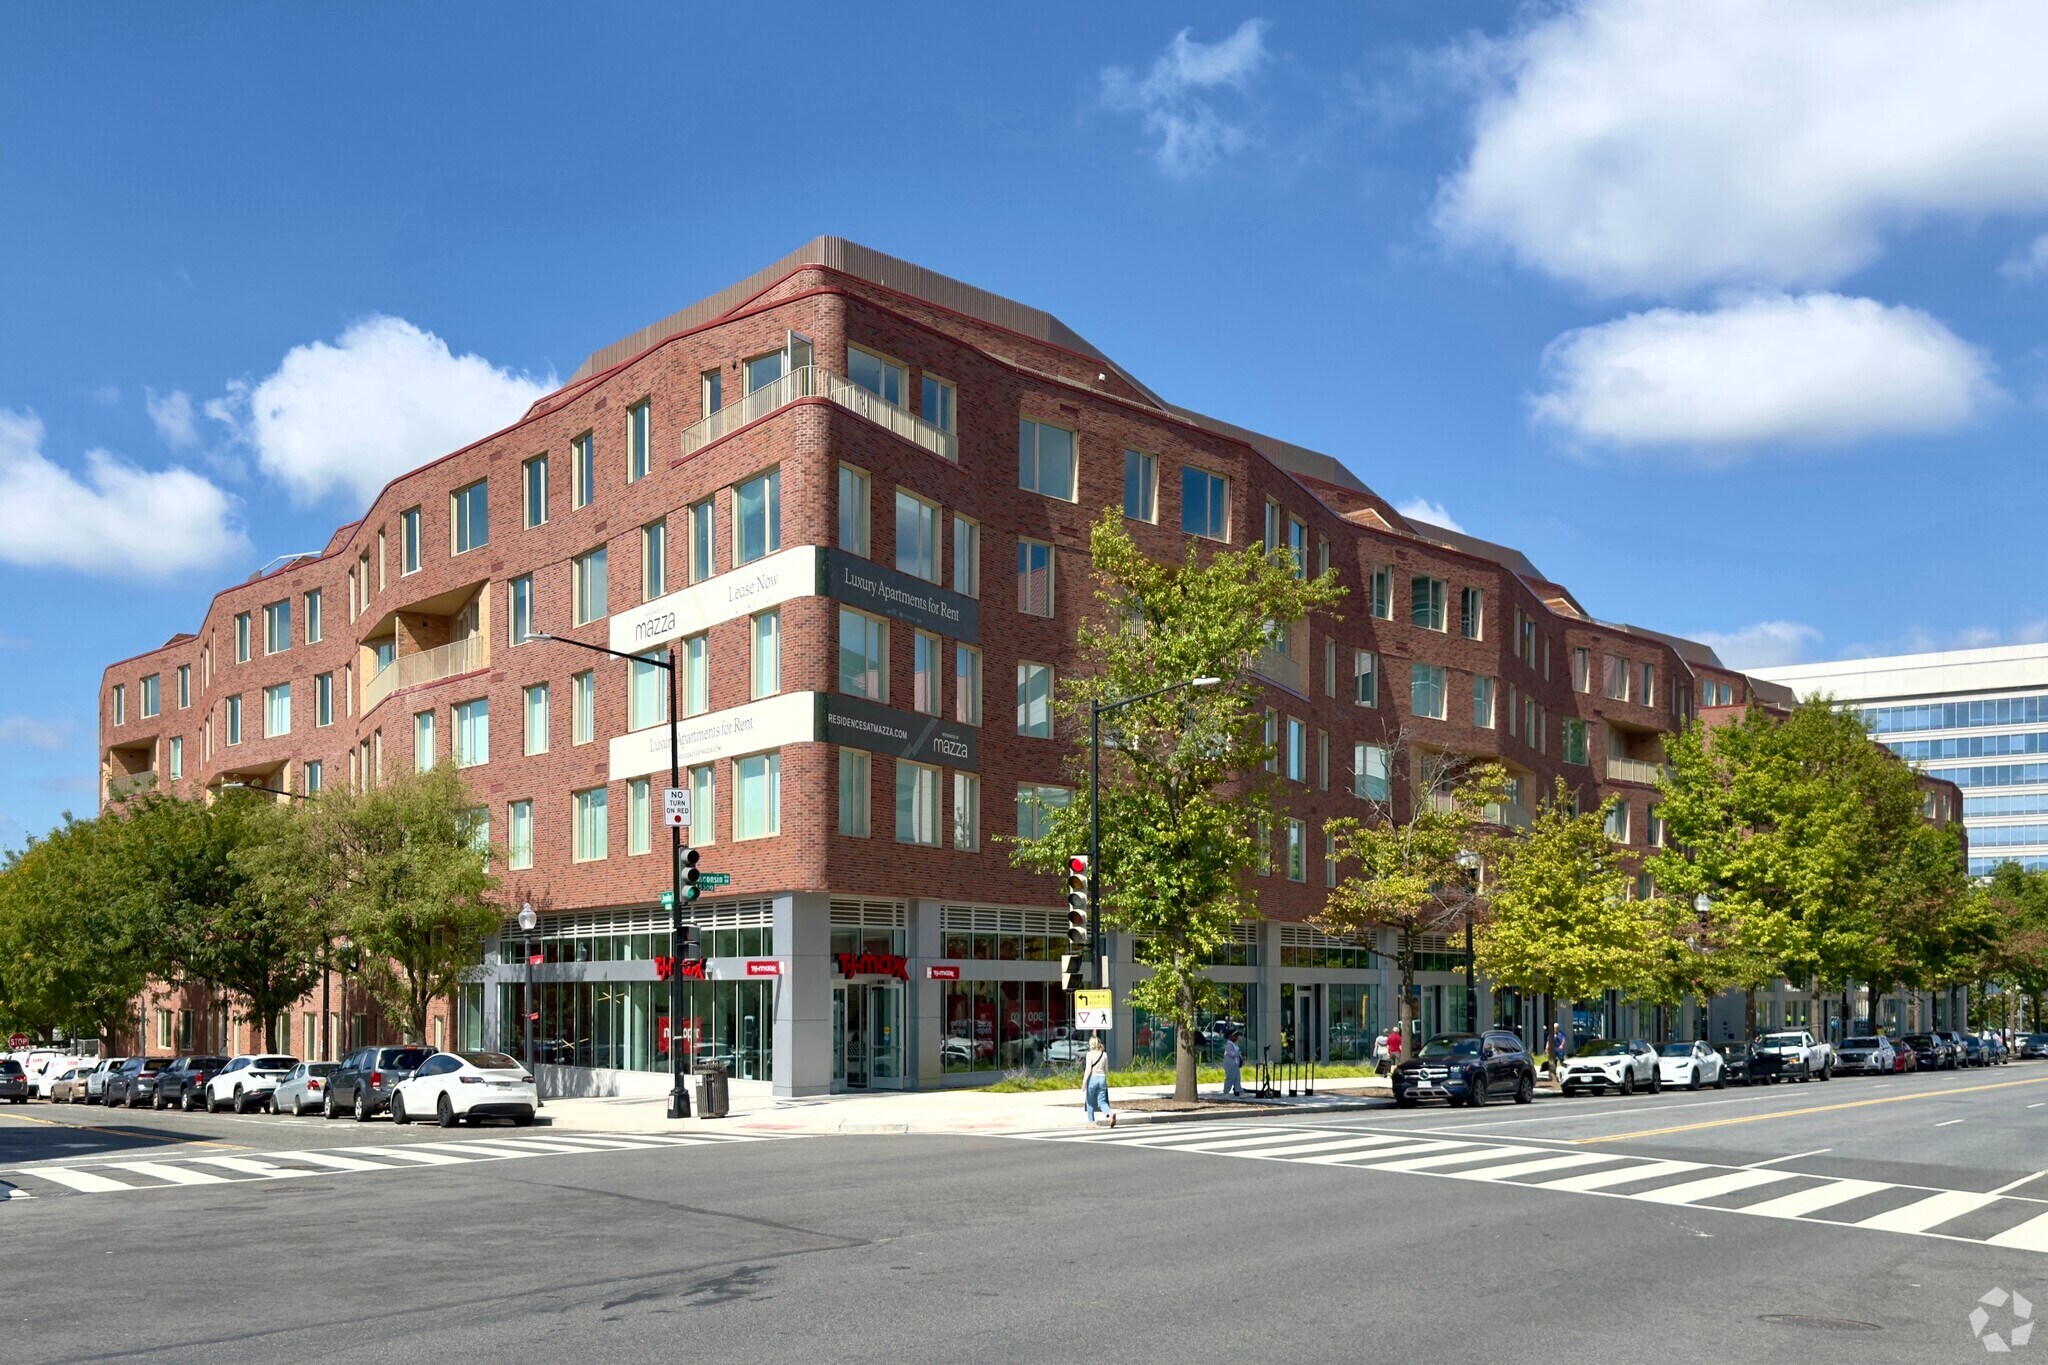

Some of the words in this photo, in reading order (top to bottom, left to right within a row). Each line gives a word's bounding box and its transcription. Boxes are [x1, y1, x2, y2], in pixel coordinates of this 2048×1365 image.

[728, 582, 754, 602] Lease
[757, 573, 778, 592] Now
[845, 567, 877, 597] Luxury
[878, 580, 927, 611] Apartments
[928, 597, 940, 614] for
[940, 601, 960, 622] Rent
[635, 612, 676, 642] mazza
[649, 737, 673, 753] Luxur
[677, 725, 720, 749] Apartments
[721, 720, 733, 736] for
[734, 717, 753, 733] Rent
[828, 713, 908, 740] RESIDENCESATMAZZA.COM
[933, 737, 968, 759] mazza
[671, 791, 683, 799] NO
[10, 1038, 27, 1046] STOP
